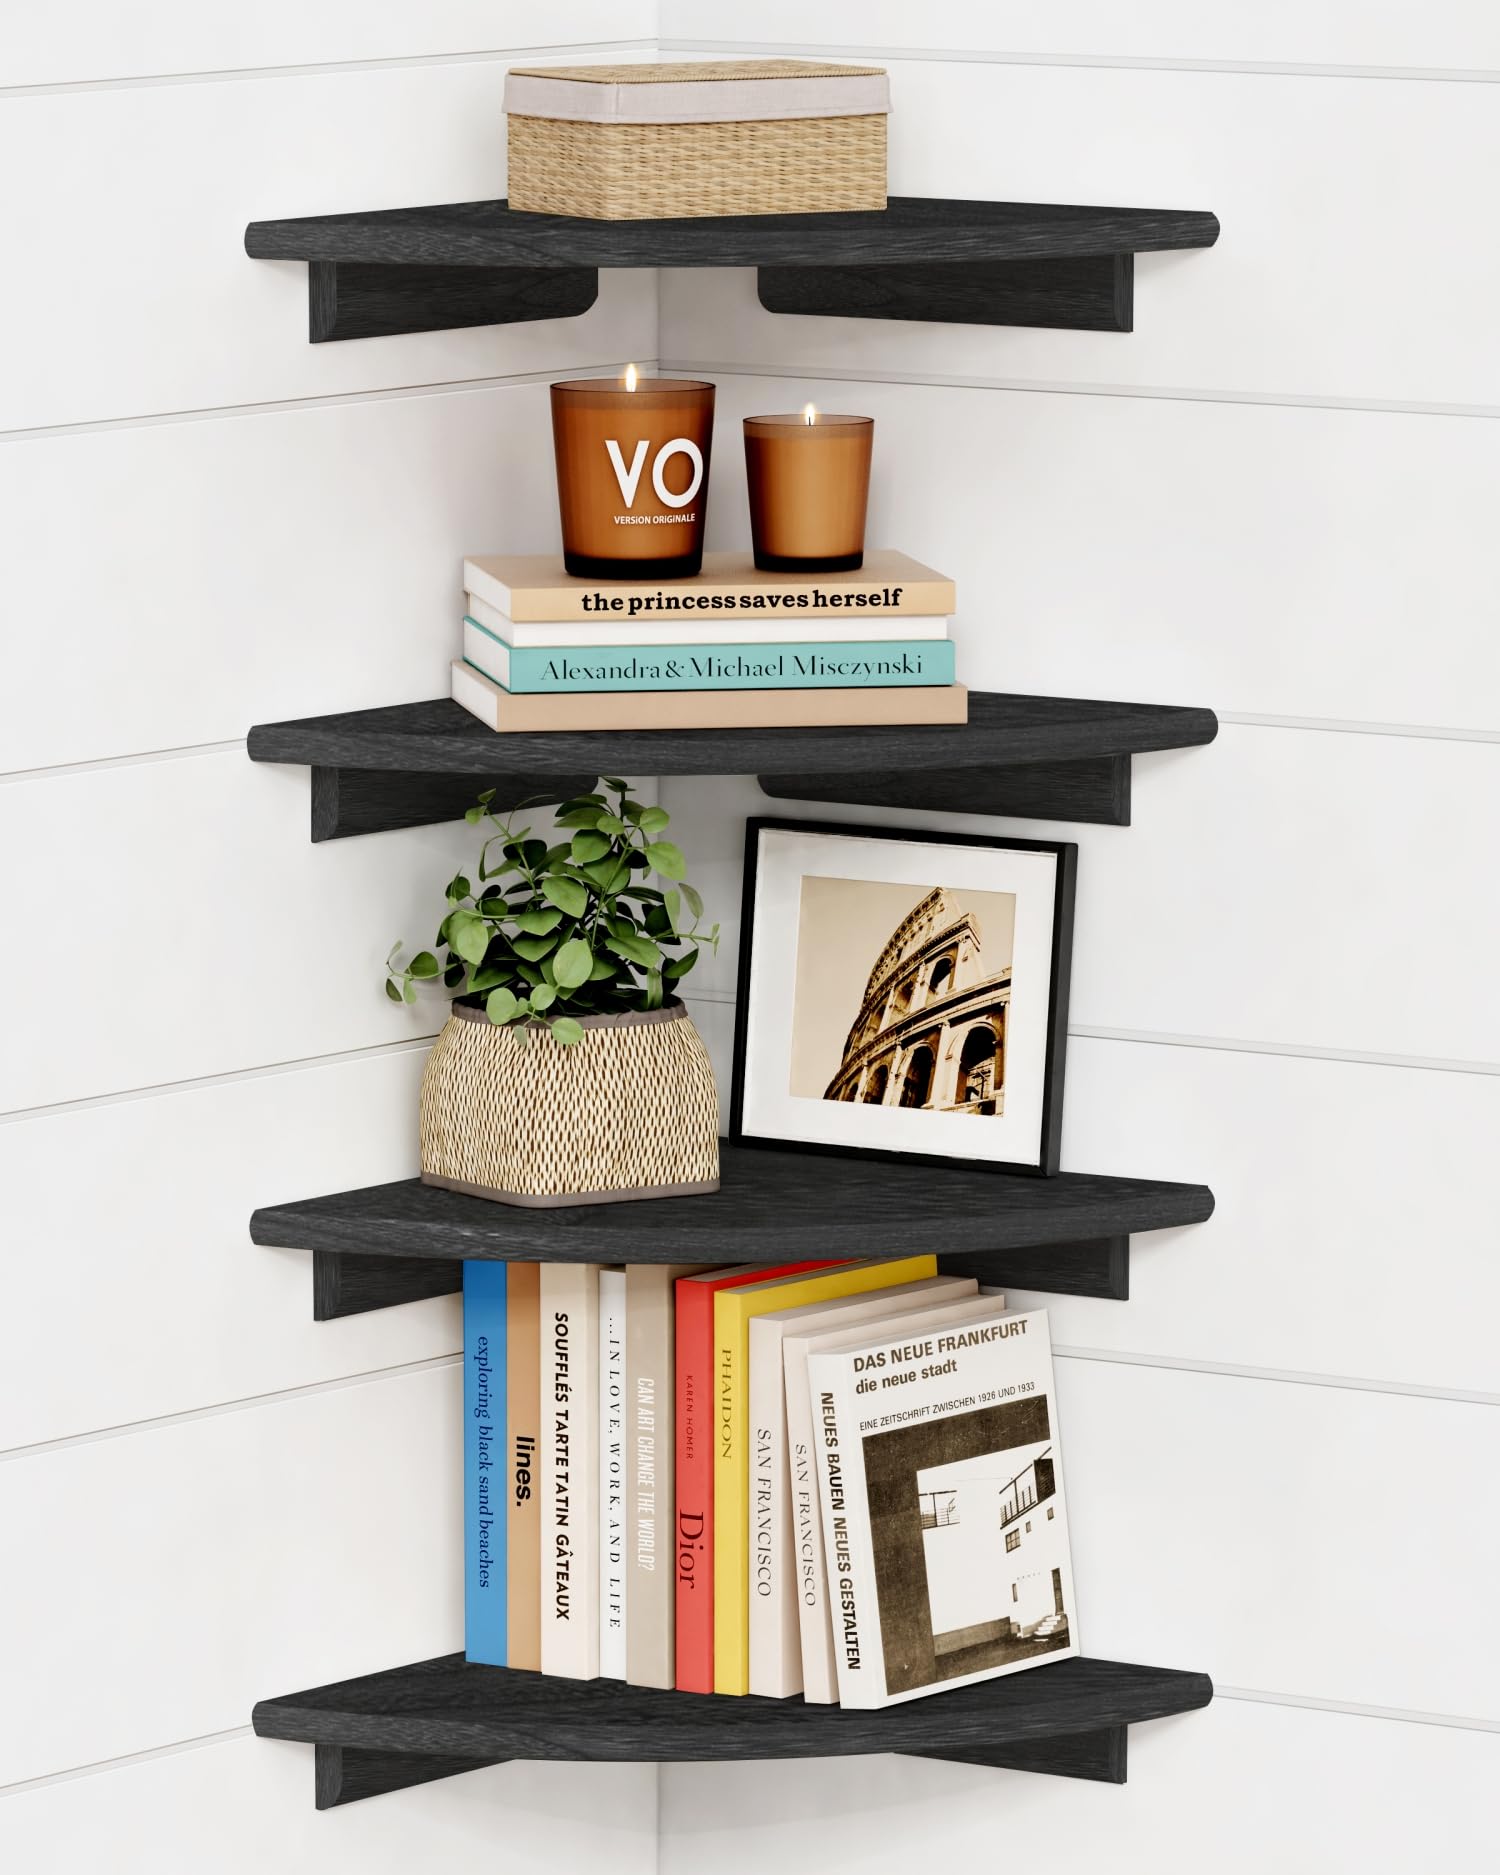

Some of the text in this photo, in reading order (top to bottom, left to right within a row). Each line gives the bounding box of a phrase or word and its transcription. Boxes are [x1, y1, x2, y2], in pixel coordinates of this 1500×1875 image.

[605, 438, 703, 508] VO
[582, 588, 904, 616] the princess saves herself
[541, 653, 923, 681] Alexandra & Michael Misczynski
[853, 1319, 1028, 1373] DAS NEUE FRANKFURT
[855, 1359, 958, 1395] die neue stadt
[608, 1370, 620, 1433] LOVE,
[685, 1375, 694, 1460] KAREN HOMER
[722, 1349, 732, 1459] PHAIDON
[859, 1381, 1035, 1431] EINE ZEITSCHRIFT ZWISCHEN 1926 UND 1933
[474, 1337, 494, 1588] exploring black sand beaches
[516, 1436, 535, 1507] lines.
[555, 1312, 574, 1620] SOUFFLÉS TARTE TATIN GÂTEAUX
[637, 1377, 655, 1571] CAN ART CHANGE THE WORLD?
[609, 1519, 621, 1563] AND
[757, 1428, 772, 1597] SAN FRANCISCO
[796, 1444, 816, 1606] SAN FRANCISCO
[821, 1392, 862, 1670] NEUES BAUEN NEUES GESTALTEN
[679, 1508, 704, 1590] Dior
[609, 1578, 621, 1628] LIFE
